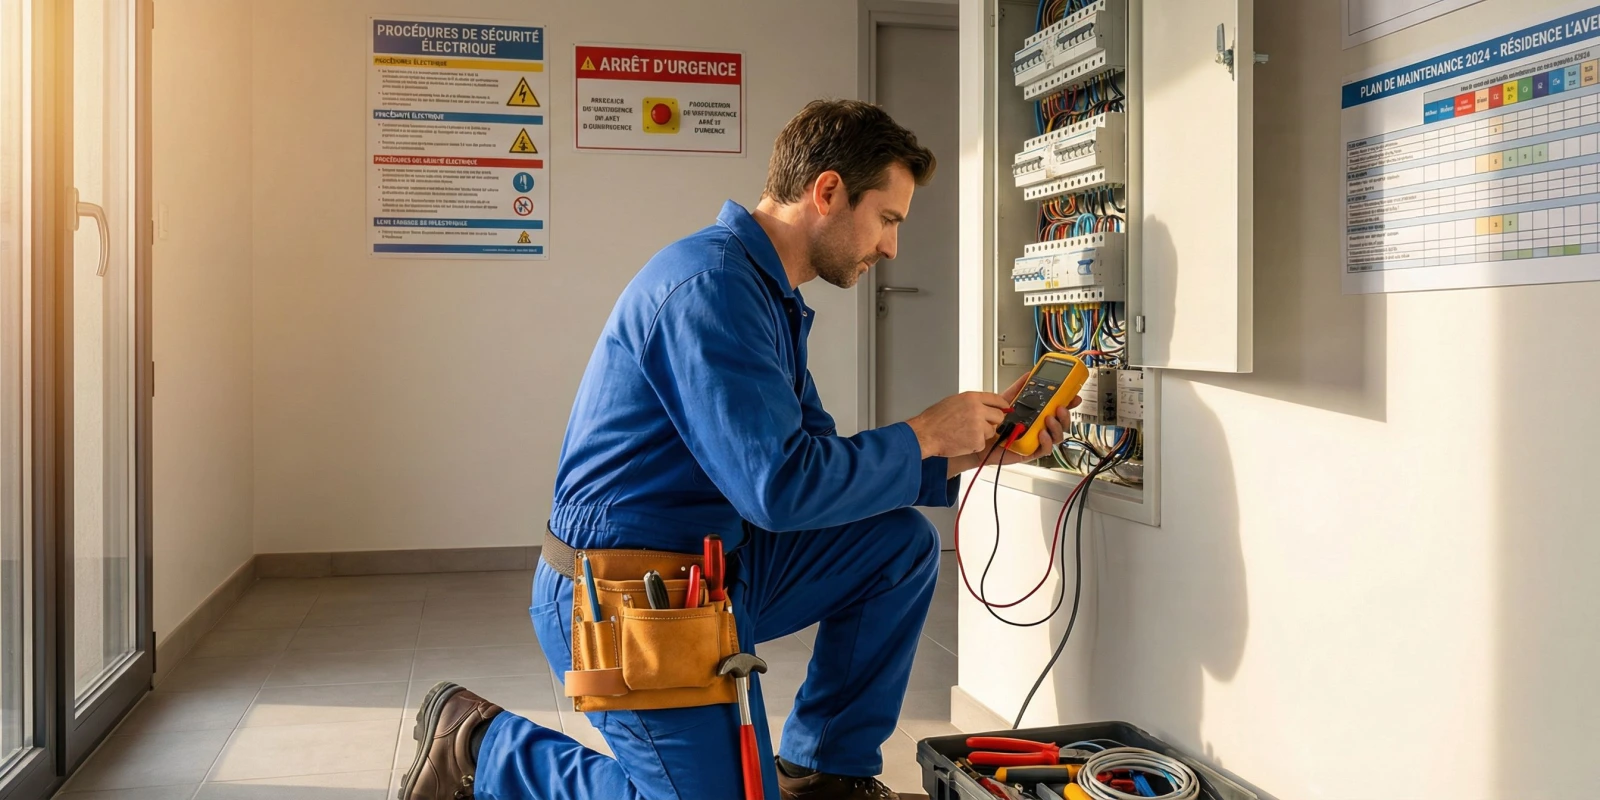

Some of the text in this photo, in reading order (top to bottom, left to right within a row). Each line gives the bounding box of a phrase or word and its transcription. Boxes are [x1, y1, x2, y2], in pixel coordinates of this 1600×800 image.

[377, 23, 540, 43] PROCÉDURES DE SÉCURITÉ
[421, 38, 496, 55] ÉLECTRIQUE
[599, 55, 737, 77] ARRÊT D'URGENCE
[1360, 82, 1383, 98] PLAN
[1384, 77, 1396, 90] DE
[1396, 55, 1464, 87] MAINTENANCE
[1465, 47, 1491, 67] 2024
[1500, 29, 1563, 57] RÉSIDENCE
